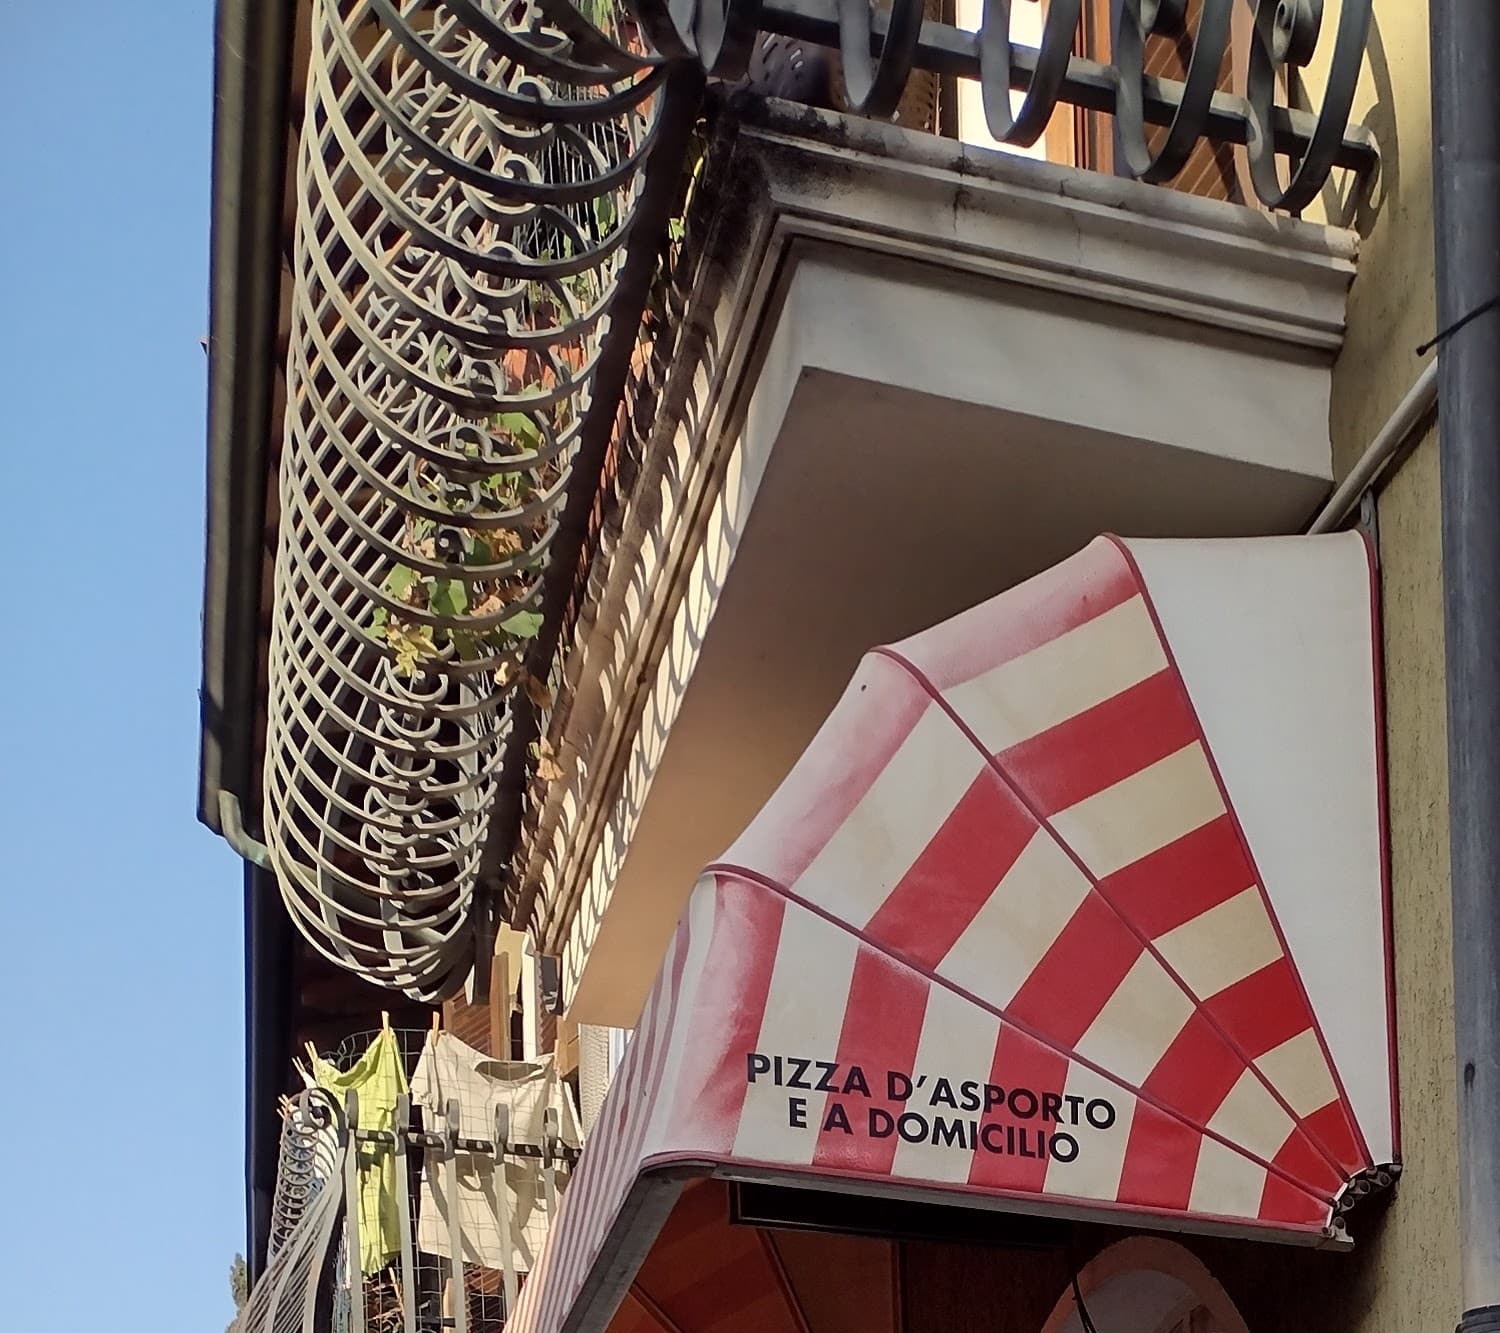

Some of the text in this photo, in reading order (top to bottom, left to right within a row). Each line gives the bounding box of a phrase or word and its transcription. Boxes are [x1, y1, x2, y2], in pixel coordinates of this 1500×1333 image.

[746, 1053, 1117, 1130] PIZZA D'ASPORTO
[788, 1097, 1080, 1163] E A DOMICILIO
